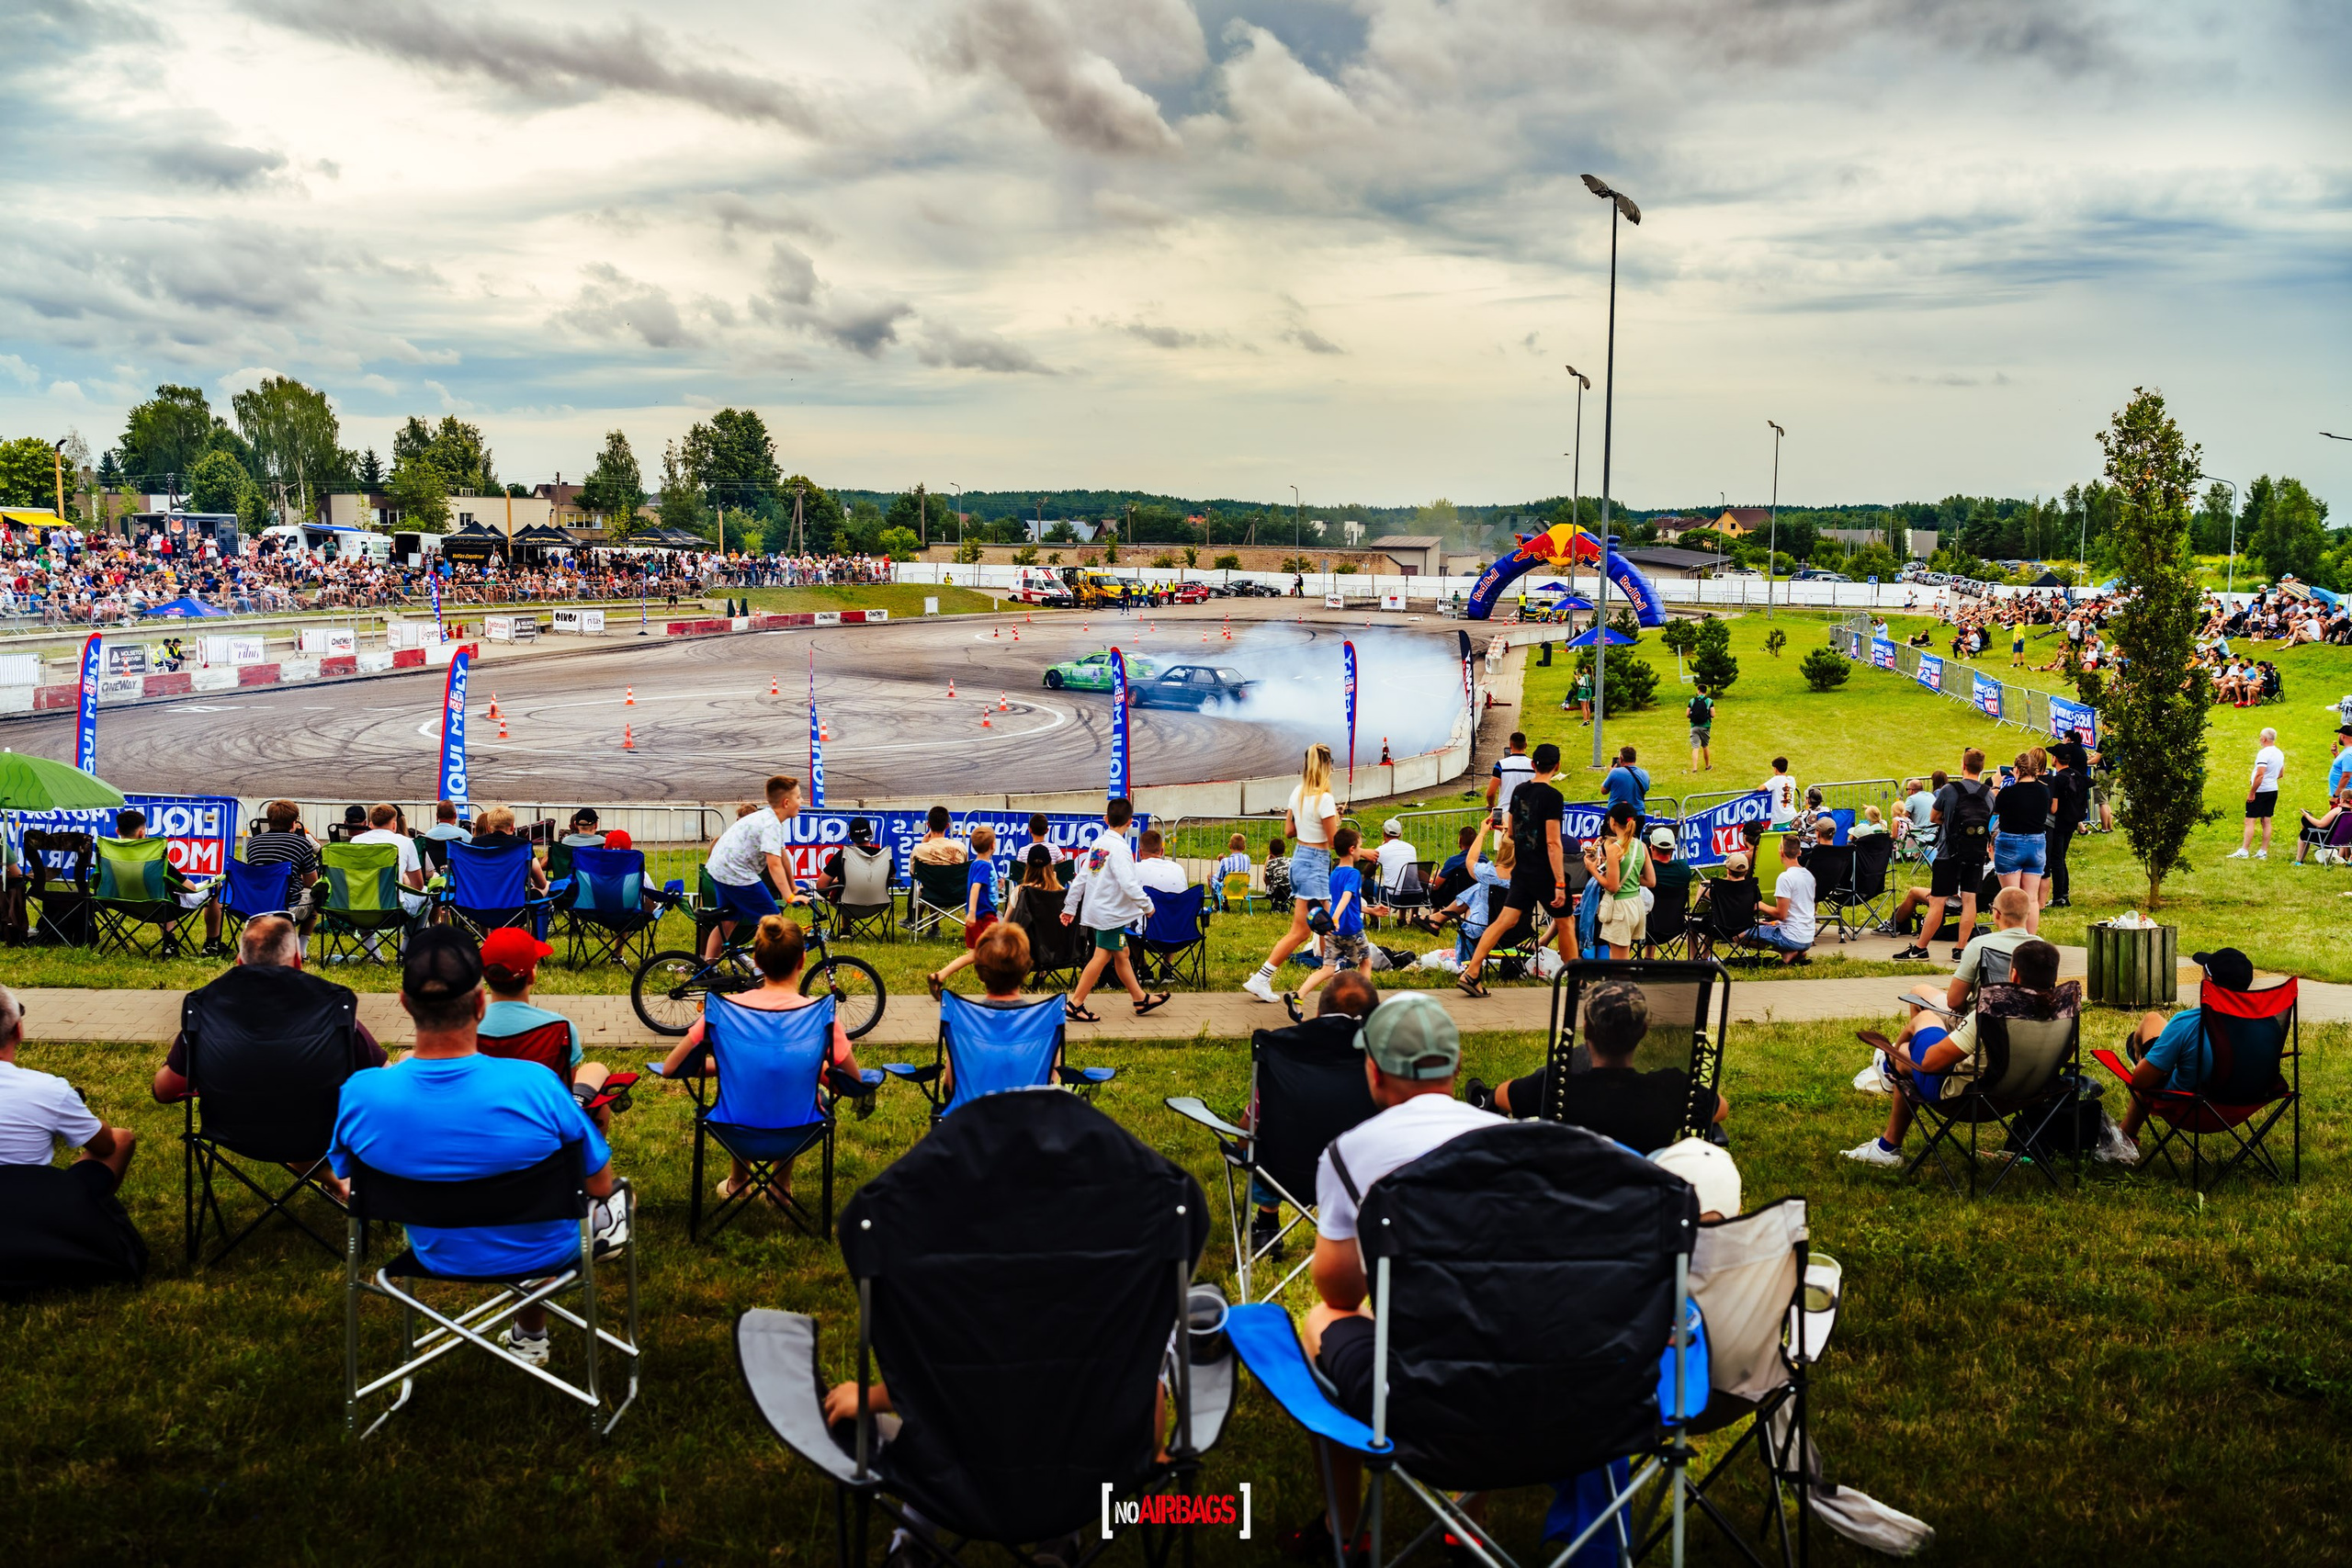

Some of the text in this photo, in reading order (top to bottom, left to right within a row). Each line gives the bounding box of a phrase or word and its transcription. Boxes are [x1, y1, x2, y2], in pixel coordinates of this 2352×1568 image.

[1473, 568, 1500, 603] Red Bull
[1619, 575, 1648, 612] Red Bull
[83, 728, 95, 775] QUI
[2076, 729, 2092, 744] OLY
